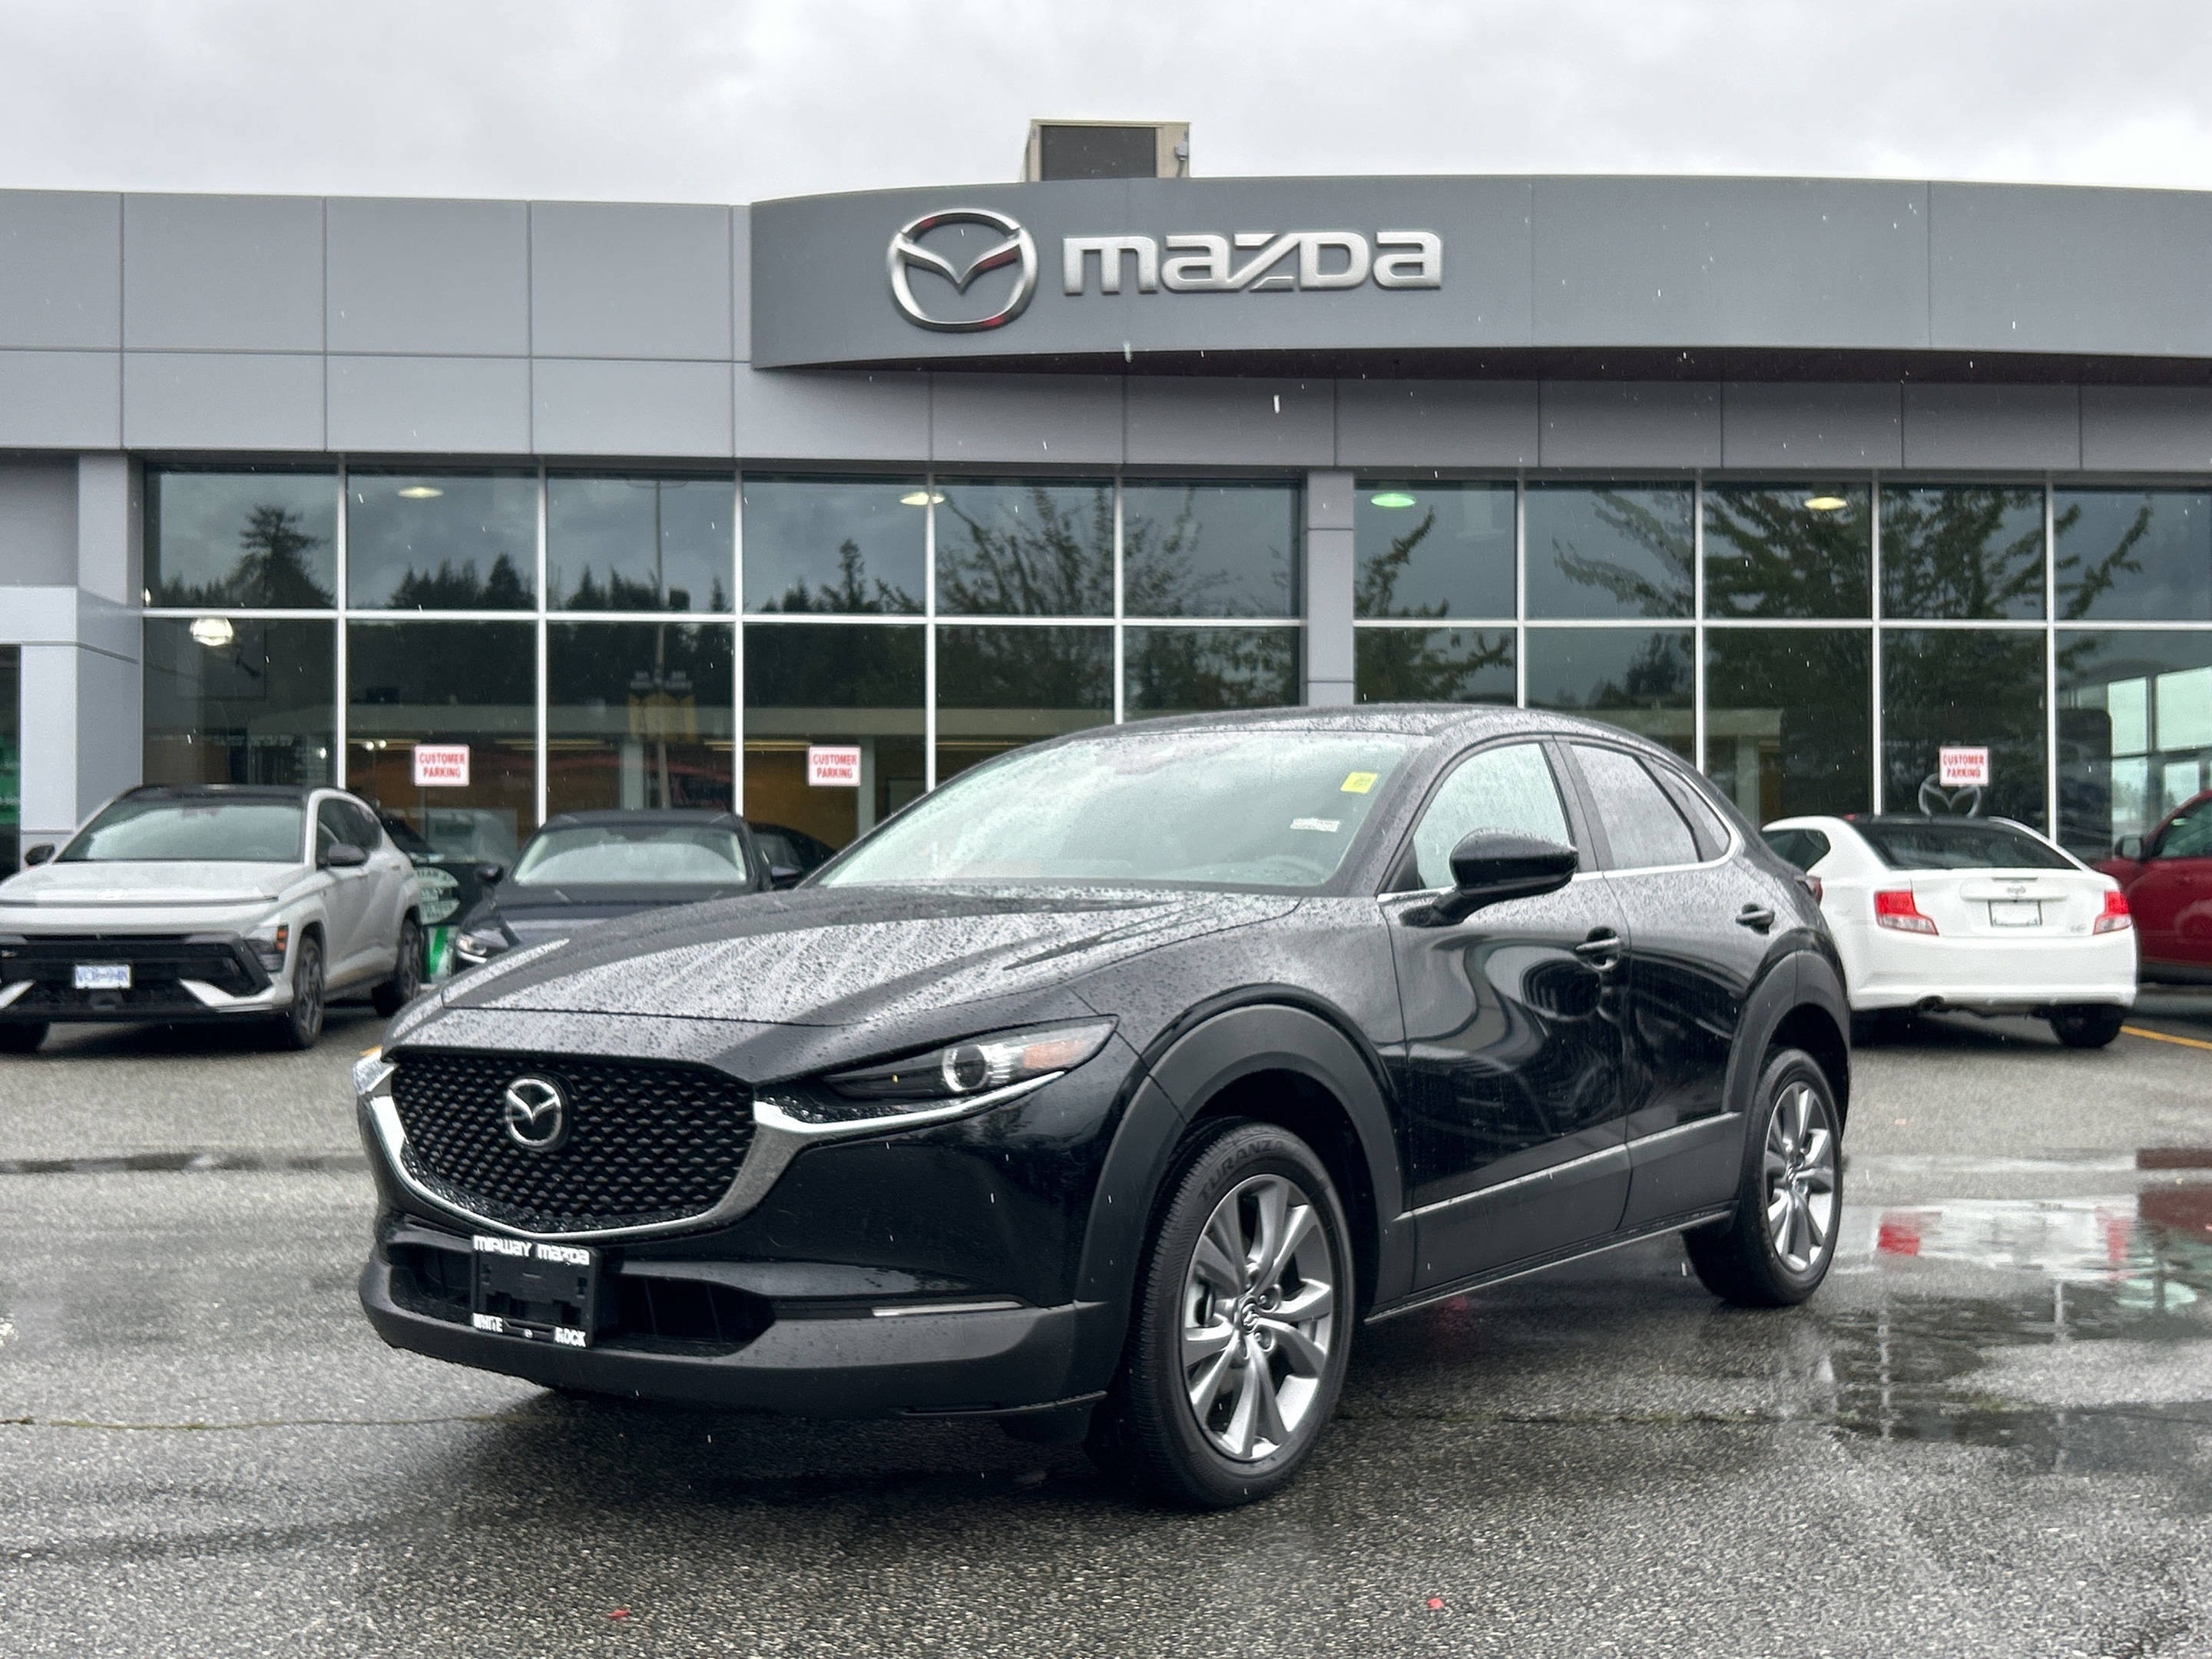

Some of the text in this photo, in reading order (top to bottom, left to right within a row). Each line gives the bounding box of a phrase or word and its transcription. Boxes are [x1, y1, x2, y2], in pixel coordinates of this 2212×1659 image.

[1062, 231, 1442, 294] mazda
[419, 753, 465, 764] CUSTOMER
[813, 753, 857, 765] CUSTOMER
[1943, 754, 1985, 766] CUSTOMER
[423, 767, 461, 778] PARKING
[816, 767, 853, 779] PARKING
[1947, 768, 1981, 778] PARKING
[472, 1313, 586, 1347] WHITE ROCK
